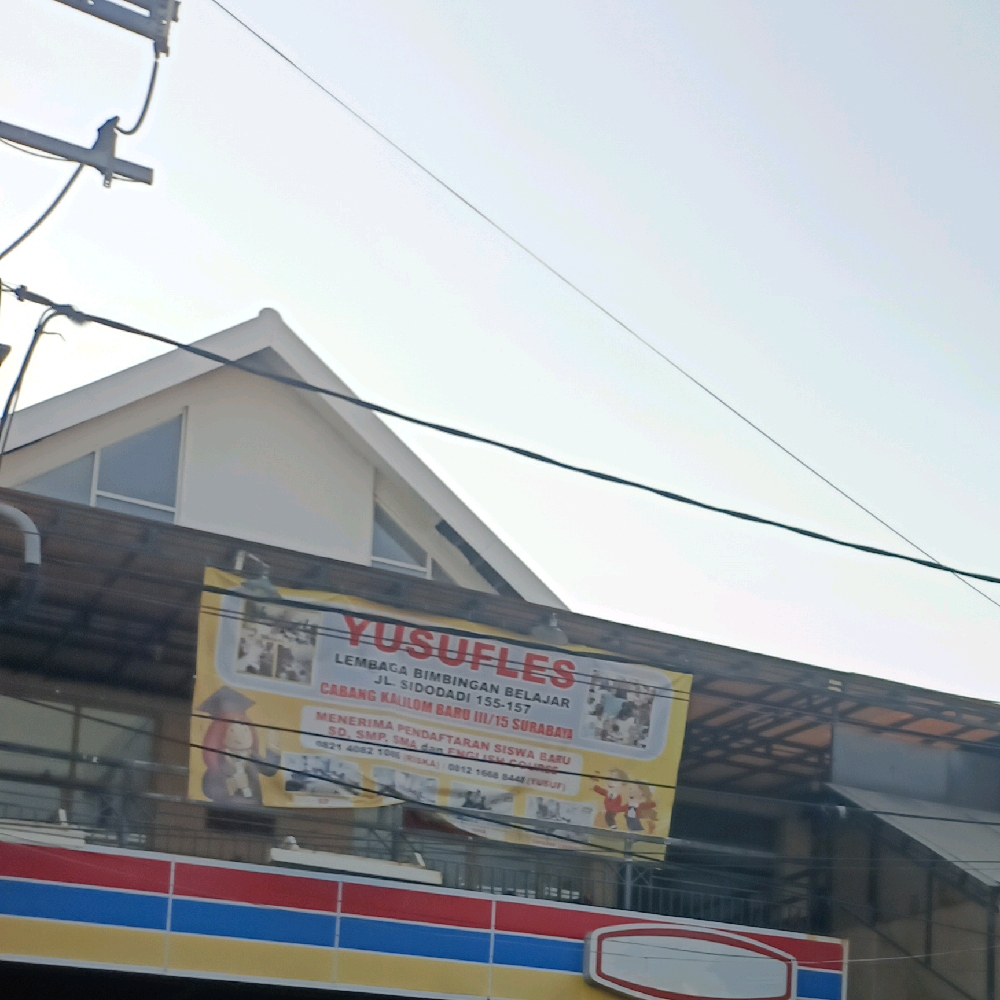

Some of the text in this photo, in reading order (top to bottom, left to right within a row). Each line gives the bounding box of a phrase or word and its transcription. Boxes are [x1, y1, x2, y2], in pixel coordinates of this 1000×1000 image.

[343, 614, 576, 689] YUSUFLES
[335, 653, 570, 709] LEMBAGA BIMBINGAN BELAJAR
[400, 679, 470, 704] SIDODADI
[476, 696, 532, 715] 155-157
[316, 711, 572, 766] MENERIMA PENDAFTARAN SISWA BARU
[320, 682, 574, 741] CABANG KALILOM BARU III/15 SURABAYA
[393, 735, 418, 750] SMA
[420, 743, 444, 756] dan
[447, 747, 506, 765] ENGLISH
